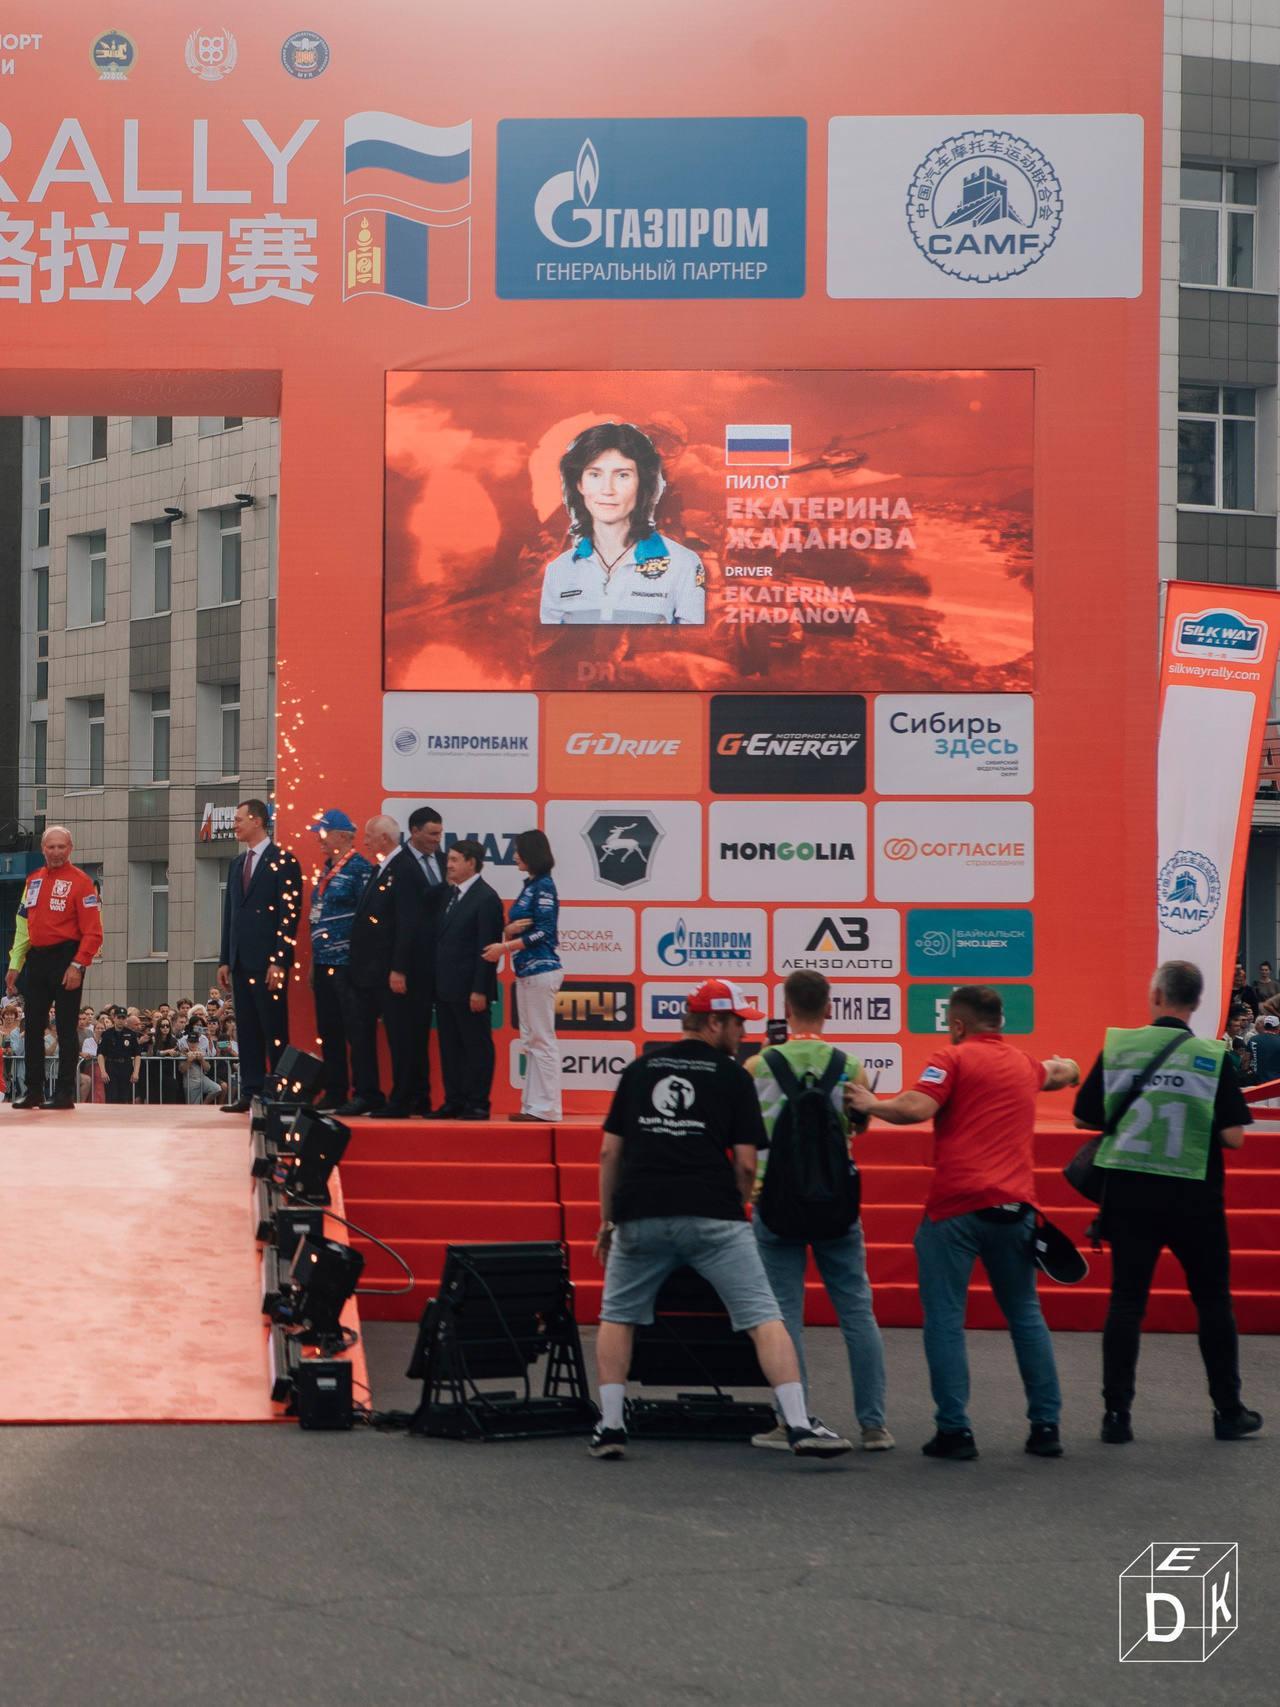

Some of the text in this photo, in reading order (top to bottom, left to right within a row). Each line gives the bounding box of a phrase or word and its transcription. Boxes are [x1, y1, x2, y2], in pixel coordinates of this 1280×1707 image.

[605, 207, 769, 248] ГАЗПРОМ
[928, 234, 1040, 255] CAMF
[535, 259, 768, 281] ГЕНЕРАЛЬНЫЙ ПАРТНЕР
[725, 474, 790, 489] ПИЛОТ
[725, 497, 913, 520] ЕКАТЕРИНА
[725, 527, 917, 553] ЖАДАНОВА
[725, 566, 773, 577] DRIVER
[725, 586, 856, 603] EKATERINA
[725, 607, 871, 624] ZHADANOVA
[1182, 624, 1258, 641] SILK WAY
[1197, 637, 1238, 646] RALLY
[1168, 662, 1261, 681] silkwayrally.com
[889, 711, 1002, 739] Сибирь
[427, 735, 528, 750] ГАЗПРОМБАНК
[934, 738, 1019, 759] здесь
[720, 842, 855, 861] MONGOLIA
[921, 843, 1025, 857] СОГЛАСИЕ
[966, 858, 1025, 867] страхование
[49, 904, 66, 912] WAY
[688, 931, 751, 948] ГАЗПРОМ
[956, 929, 1026, 938] БАЙКАЛЬСК
[956, 940, 1008, 949] ЭКО.ЦЕХ
[689, 949, 751, 959] ДОБЫЧА
[688, 960, 752, 968] ИРКУТСК
[781, 959, 893, 969] ЛЕНЗОЛОТО
[562, 1056, 626, 1074] 2ГИС
[1132, 1074, 1185, 1088] POTO
[1113, 1097, 1188, 1159] 21
